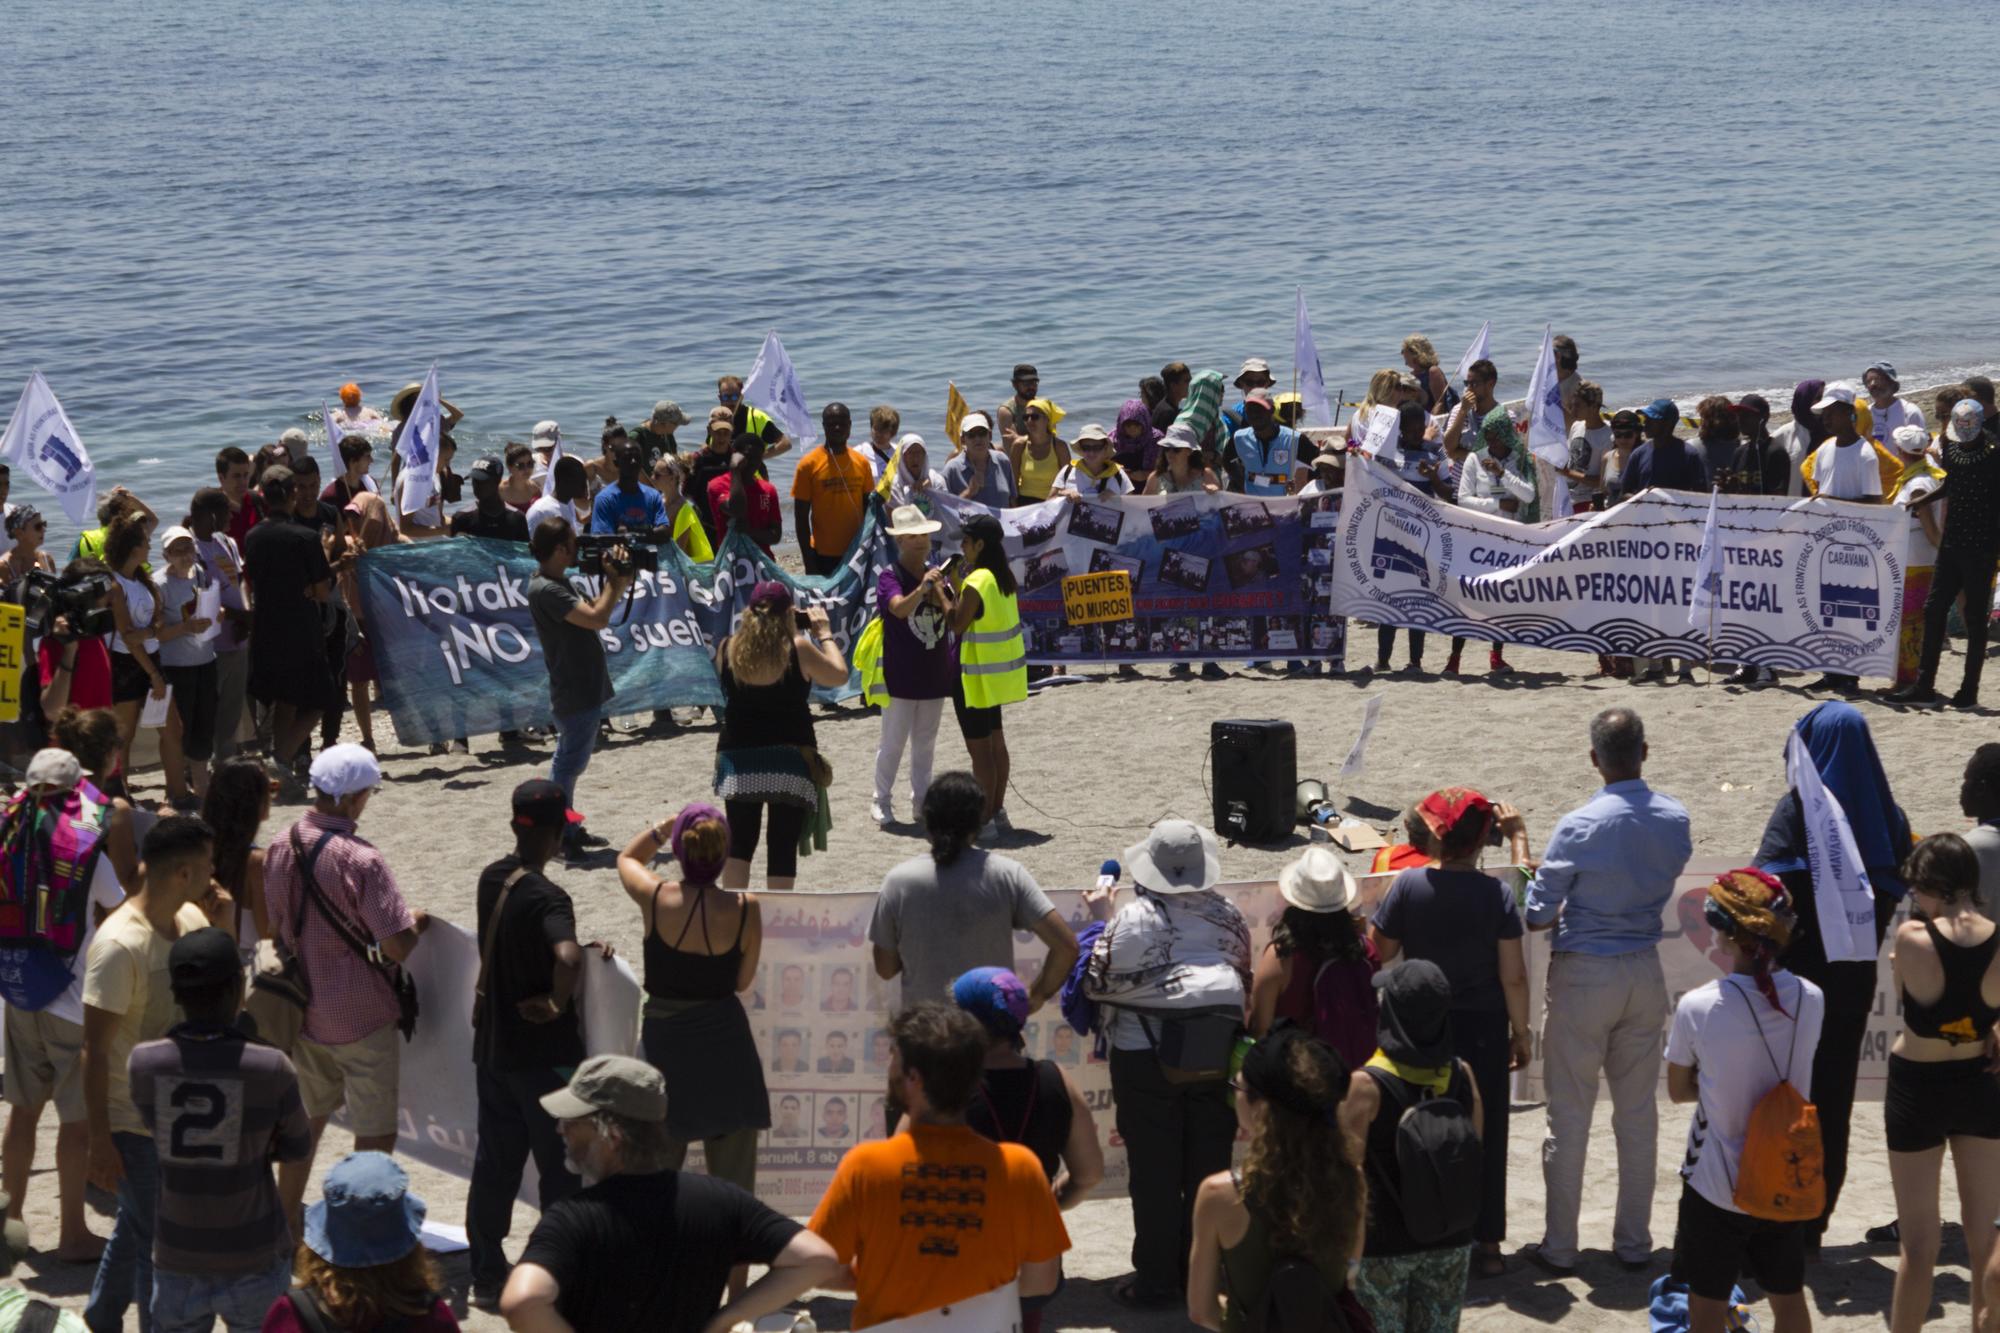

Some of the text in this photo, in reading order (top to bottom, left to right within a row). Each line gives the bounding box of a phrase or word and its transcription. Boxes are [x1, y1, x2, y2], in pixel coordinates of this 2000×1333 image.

[1383, 511, 1422, 538] CARAVANA
[1815, 520, 1885, 550] ABRIENDO FRONTERAS
[1345, 498, 1372, 585] ABRIR AS FRONTEIRAS
[1440, 532, 1452, 562] OBRINT
[1469, 539, 1783, 568] CARANA ABRIENDO FRTERAS
[1827, 551, 1869, 568] CARAVANA
[1064, 575, 1128, 602] ¡PUENTES,
[1459, 574, 1572, 603] NINGUNA
[1575, 573, 1677, 606] PERSONA
[1682, 577, 1694, 607] E
[1719, 579, 1783, 614] LEGAL
[1795, 543, 1819, 632] ABRIR AS FRONTEIRAS
[1884, 552, 1902, 636] OBRINT FRONTERES
[1067, 604, 1084, 620] NO
[1086, 598, 1130, 618] MUROS!
[440, 622, 531, 685] ¡NO
[170, 1082, 226, 1160] 2
